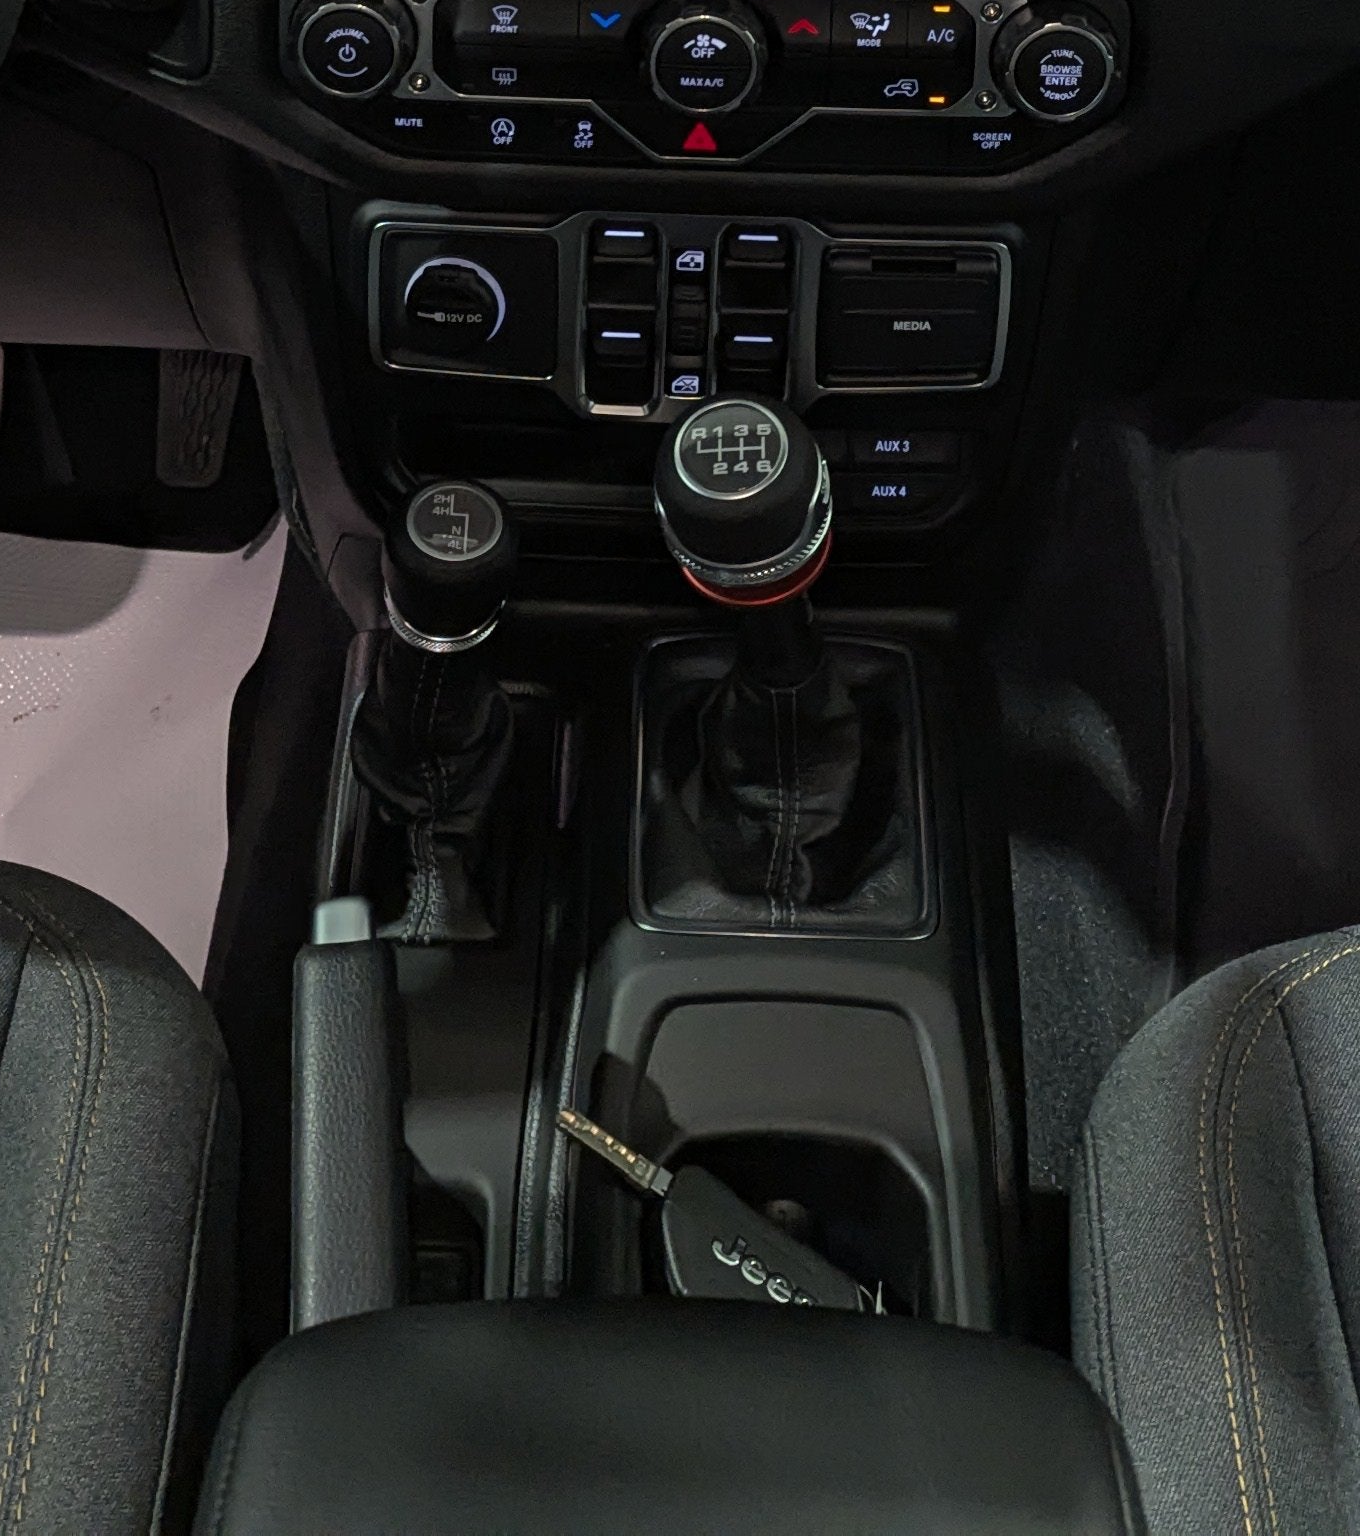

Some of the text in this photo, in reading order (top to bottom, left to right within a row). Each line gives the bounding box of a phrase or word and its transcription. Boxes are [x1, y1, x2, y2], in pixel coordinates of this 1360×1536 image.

[329, 29, 365, 41] VOLUME
[490, 24, 518, 35] FRONT
[926, 28, 955, 44] A/C
[856, 38, 882, 48] MODE
[691, 47, 716, 59] OFF
[1051, 49, 1075, 60] TUNE
[1040, 64, 1083, 75] BROWSE
[680, 77, 724, 88] MAX A/C
[1045, 76, 1078, 87] ENTER
[1044, 89, 1076, 102] SCROLL
[394, 117, 424, 128] MUTE
[492, 135, 514, 146] OFF
[972, 132, 1012, 142] SCREEN
[573, 139, 594, 150] OFF
[980, 141, 1001, 150] OFF
[447, 313, 483, 323] 12V DC
[893, 321, 932, 331] MEDIA
[691, 423, 772, 440] R 1 3 5
[875, 440, 910, 452] AUX 3
[713, 460, 774, 475] 2 4 6
[871, 486, 906, 497] AUX 4
[433, 494, 451, 504] 2H
[432, 506, 450, 516] 4H
[451, 525, 462, 535] N
